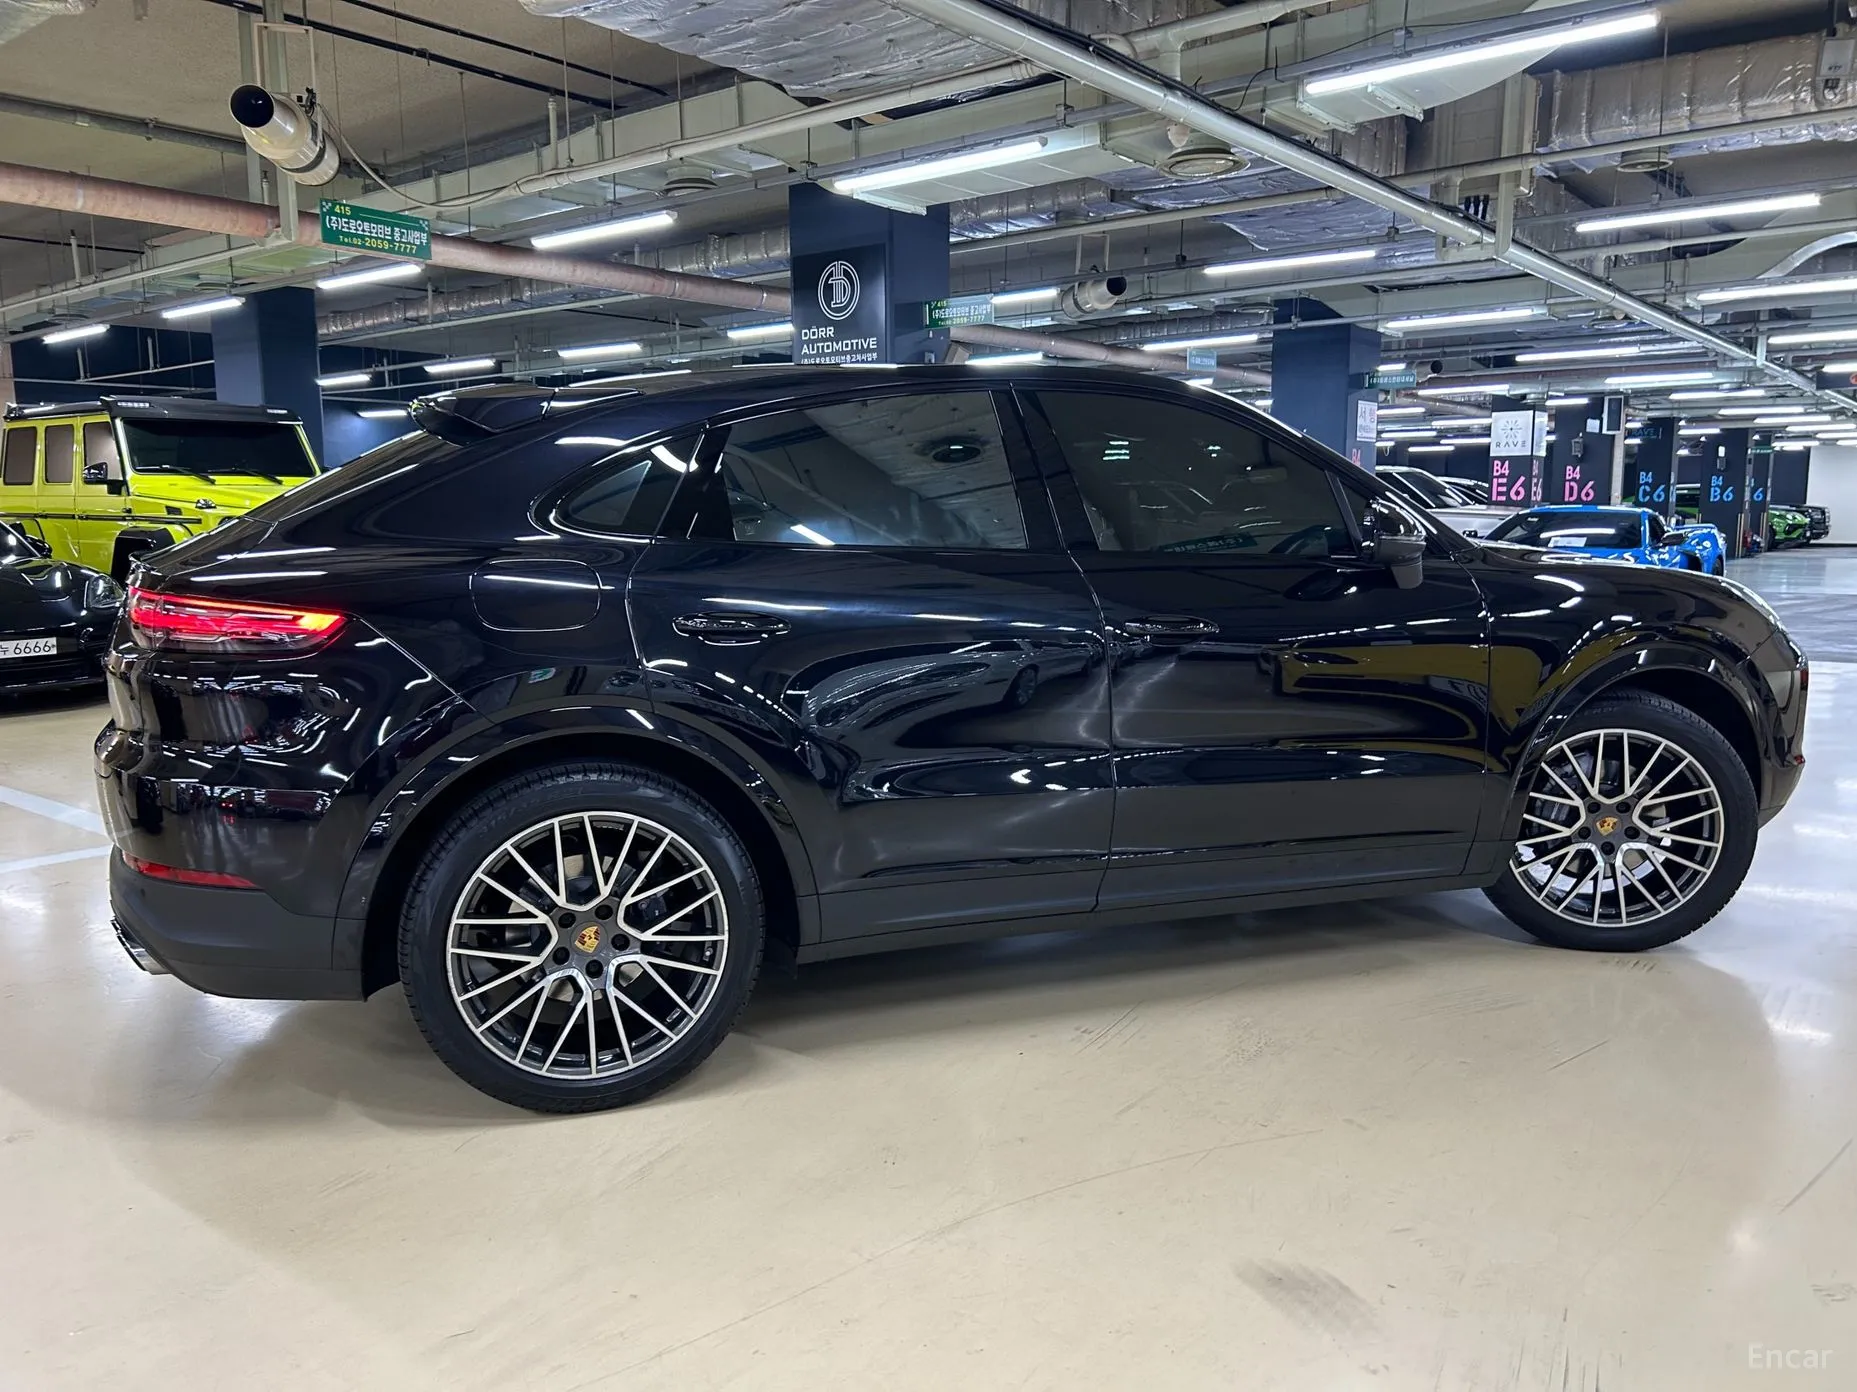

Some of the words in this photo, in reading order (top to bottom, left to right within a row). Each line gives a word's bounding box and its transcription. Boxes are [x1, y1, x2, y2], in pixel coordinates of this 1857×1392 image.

[334, 205, 351, 215] 415
[393, 227, 428, 246] 중고사업부
[801, 337, 878, 355] AUTOMOTIVE
[1495, 440, 1526, 448] RAVE
[1493, 460, 1509, 476] B4
[1565, 465, 1580, 480] B4
[1639, 471, 1653, 484] B4
[1711, 475, 1723, 487] B4
[13, 640, 51, 655] 6666
